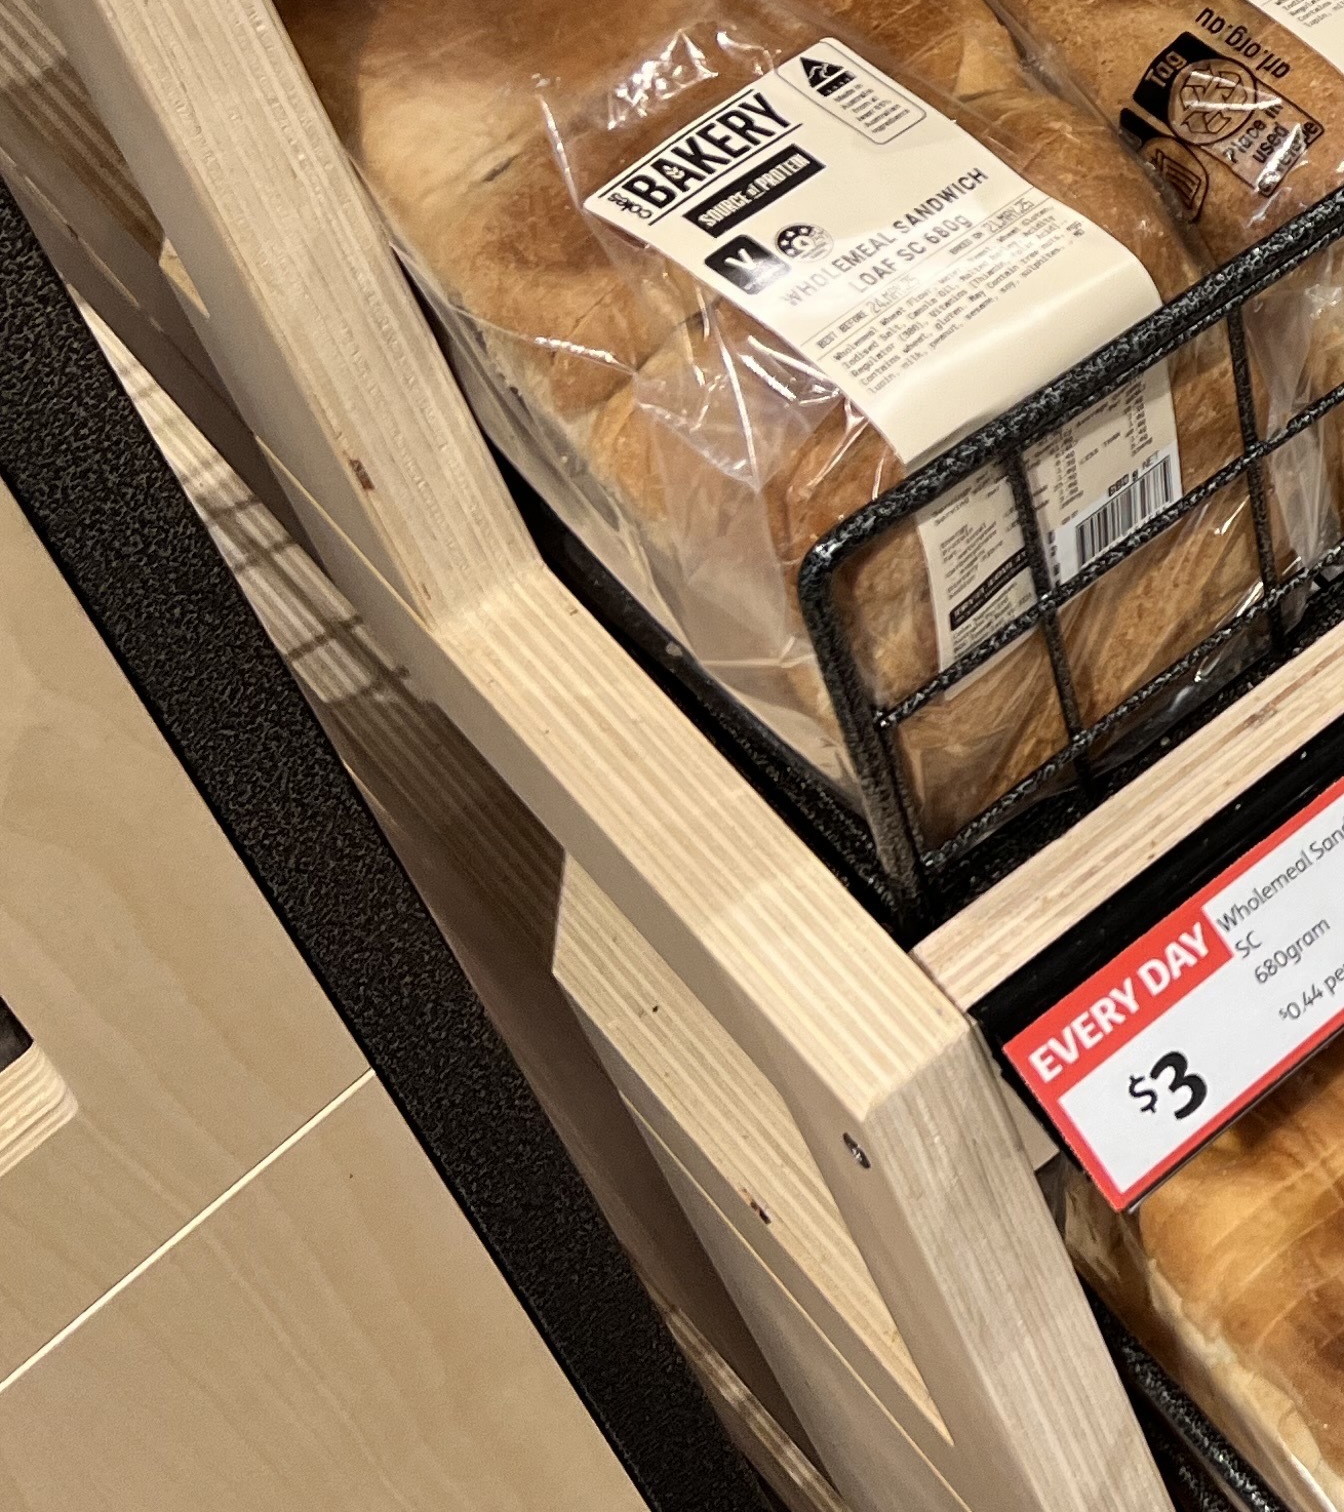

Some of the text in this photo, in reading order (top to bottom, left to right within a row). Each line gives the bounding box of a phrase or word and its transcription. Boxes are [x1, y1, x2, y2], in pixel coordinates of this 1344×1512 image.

[621, 91, 790, 209] BAKERY
[698, 190, 746, 228] SOURCE
[759, 153, 810, 191] PROTEIN
[780, 167, 989, 307] WHOLEMEAL SANDWICH
[849, 212, 973, 293] LOAF SC 680g
[1216, 853, 1314, 933] Wholemeal
[1234, 931, 1263, 959] SC
[1253, 917, 1332, 984] 680gram
[1028, 921, 1210, 1083] EVERY DAY
[1128, 1050, 1207, 1120] $3
